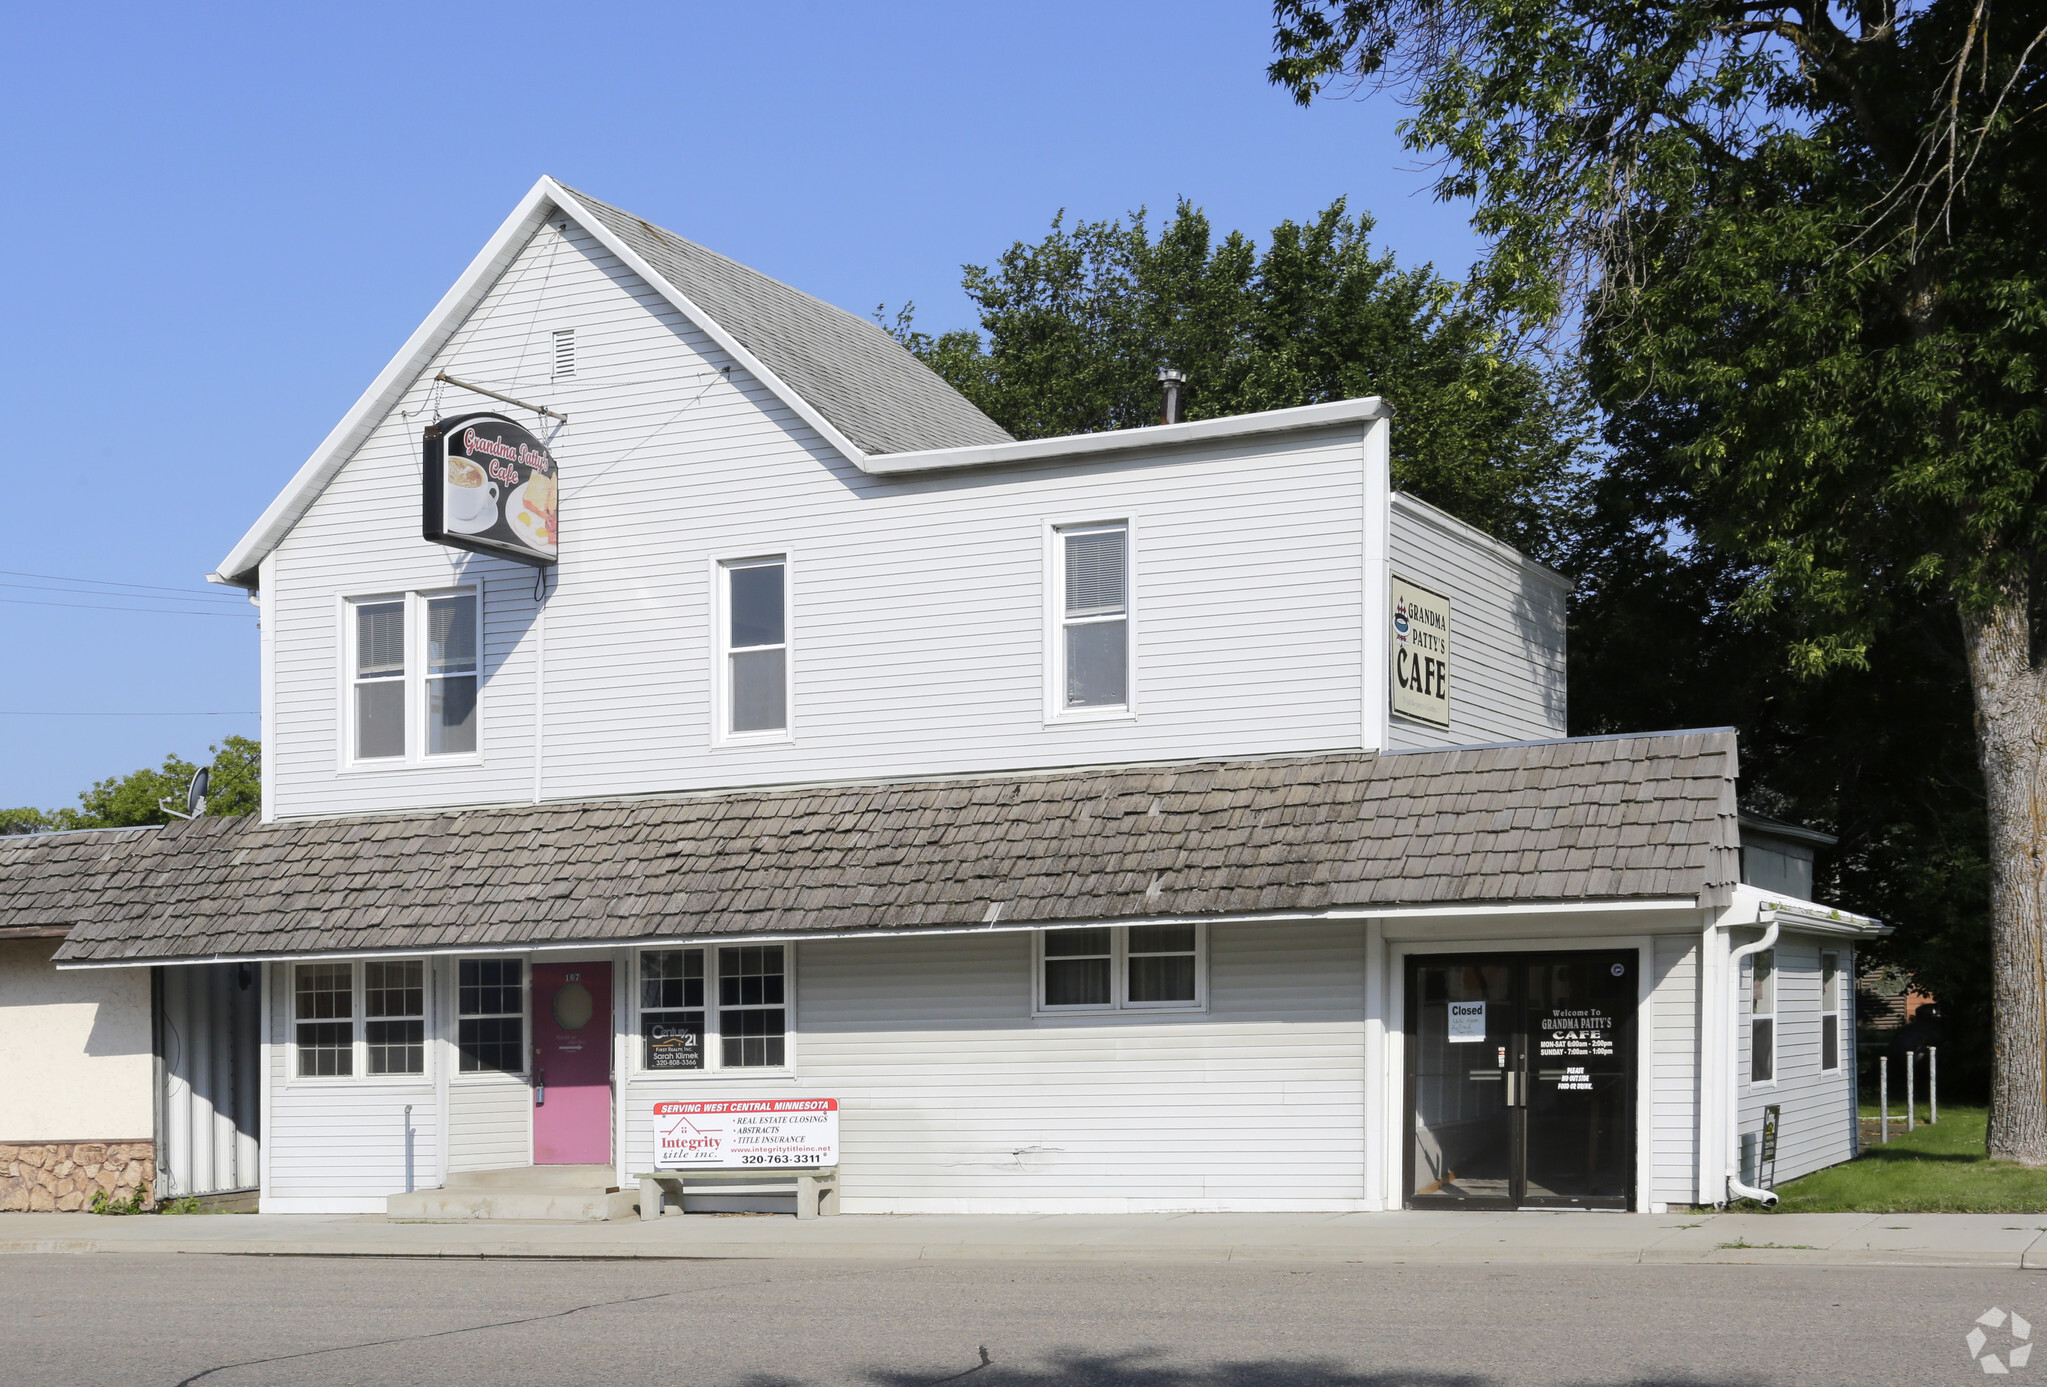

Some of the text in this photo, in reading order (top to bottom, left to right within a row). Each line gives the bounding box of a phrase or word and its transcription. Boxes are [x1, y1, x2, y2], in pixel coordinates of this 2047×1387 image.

[464, 427, 549, 475] Grandma Patty's
[489, 458, 519, 488] Cafe
[1408, 602, 1446, 632] GRANDMA
[1412, 628, 1445, 655] PATTY'S
[1397, 647, 1446, 701] CAFE
[1452, 1005, 1483, 1016] Closed
[1552, 1008, 1601, 1017] Welcome To
[1541, 1017, 1612, 1030] GRANDMA PATTY'S
[652, 1025, 697, 1046] Century 21
[1552, 1030, 1601, 1040] CAFE
[1591, 1040, 1613, 1048] 2:00pm
[653, 1052, 674, 1060] Sarah
[1540, 1048, 1564, 1056] SUNDAY
[1592, 1048, 1613, 1056] 1:00pm
[1569, 1074, 1590, 1082] OUTSIDE
[661, 1100, 829, 1113] SERVING WEST CENTRAL MINNESOTA
[737, 1115, 828, 1125] REAL ESTATE CLOSINGS
[736, 1126, 780, 1134] ABSTRACTS
[661, 1136, 722, 1150] Integrity
[663, 1149, 718, 1159] title inc.
[730, 1145, 831, 1154] www.integritytitleinc.net
[741, 1154, 821, 1164] 320-763-3311
